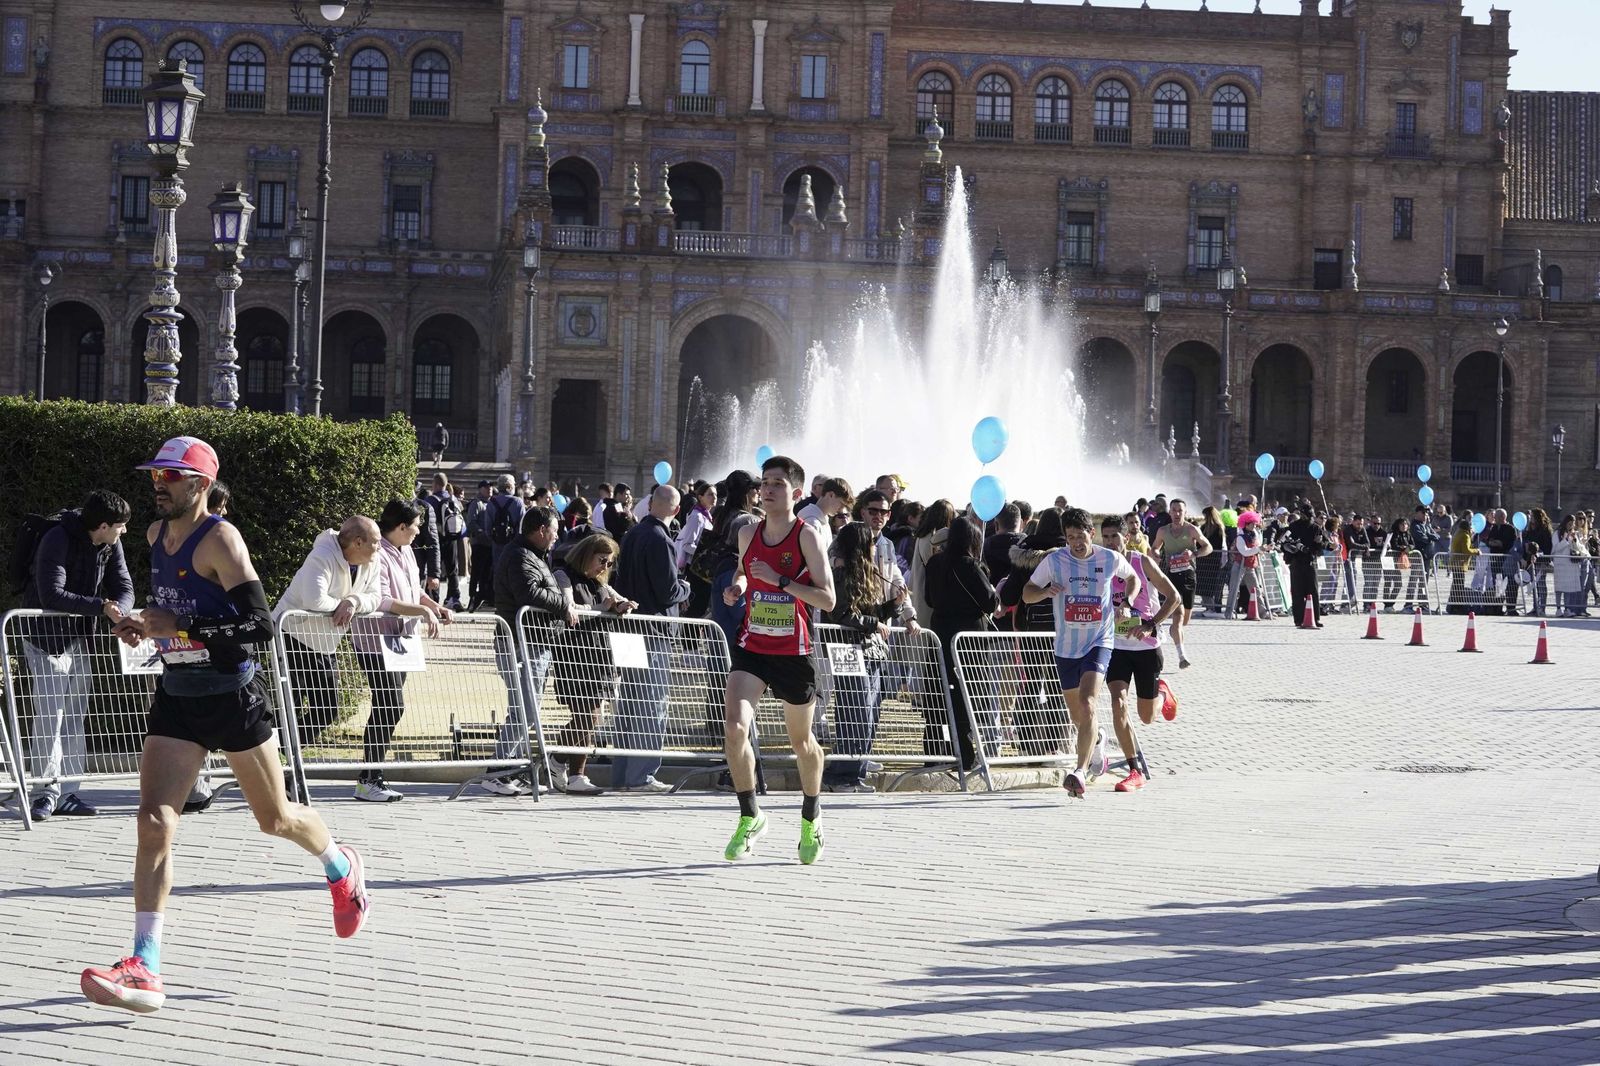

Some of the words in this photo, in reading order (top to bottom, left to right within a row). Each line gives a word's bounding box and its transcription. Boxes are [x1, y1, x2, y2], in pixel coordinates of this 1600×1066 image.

[763, 594, 790, 602] ZURICH
[750, 615, 766, 624] LIAM
[766, 617, 795, 626] COTTER
[1074, 613, 1092, 621] LALO
